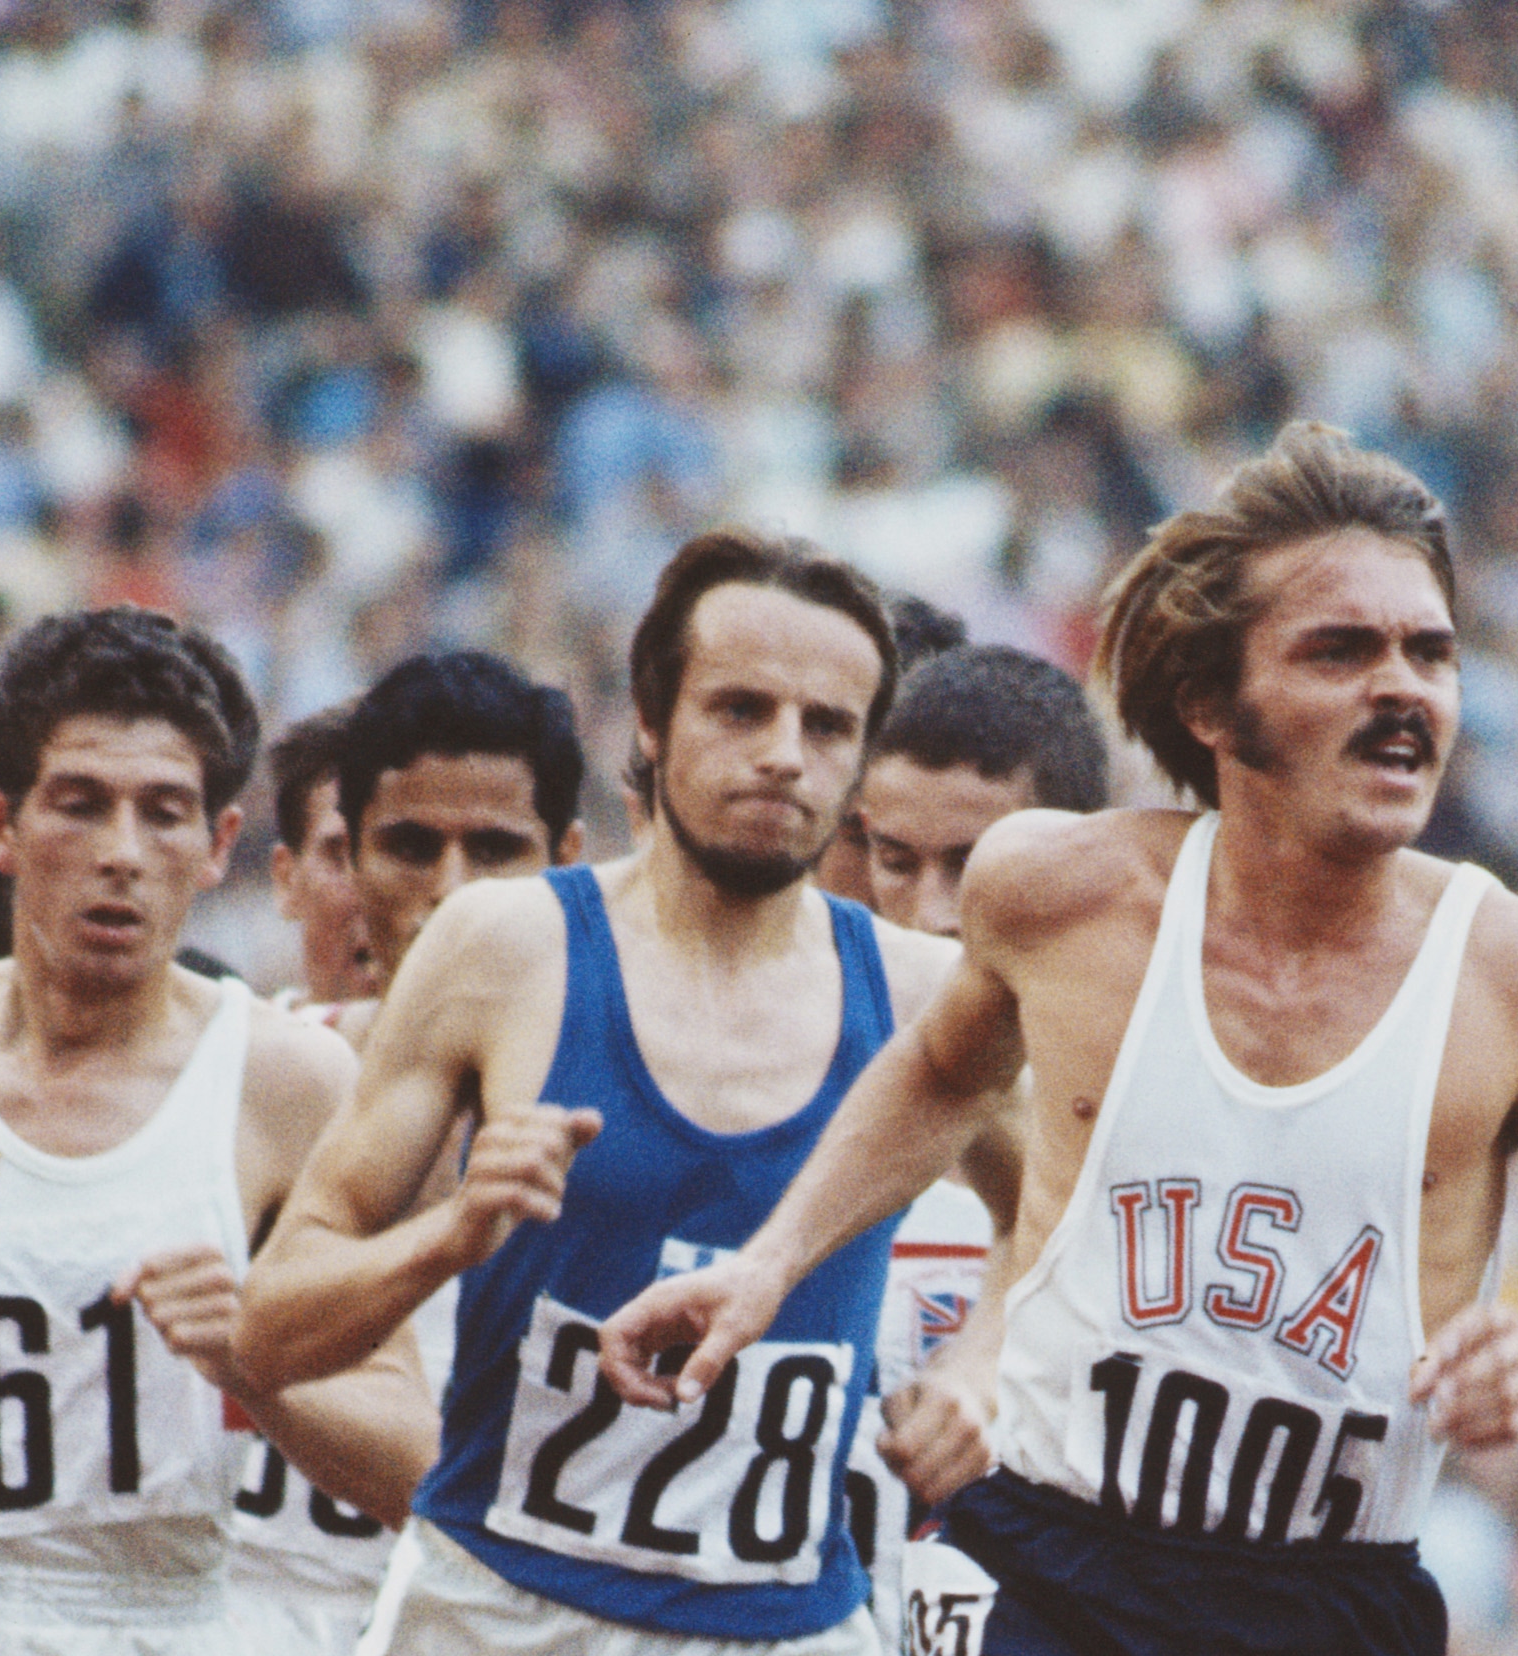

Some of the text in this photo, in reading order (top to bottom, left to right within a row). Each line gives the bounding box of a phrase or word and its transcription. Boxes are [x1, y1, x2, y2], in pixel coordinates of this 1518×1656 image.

[1109, 1178, 1383, 1381] USA
[522, 1320, 836, 1563] 228
[1090, 1352, 1389, 1543] 1005
